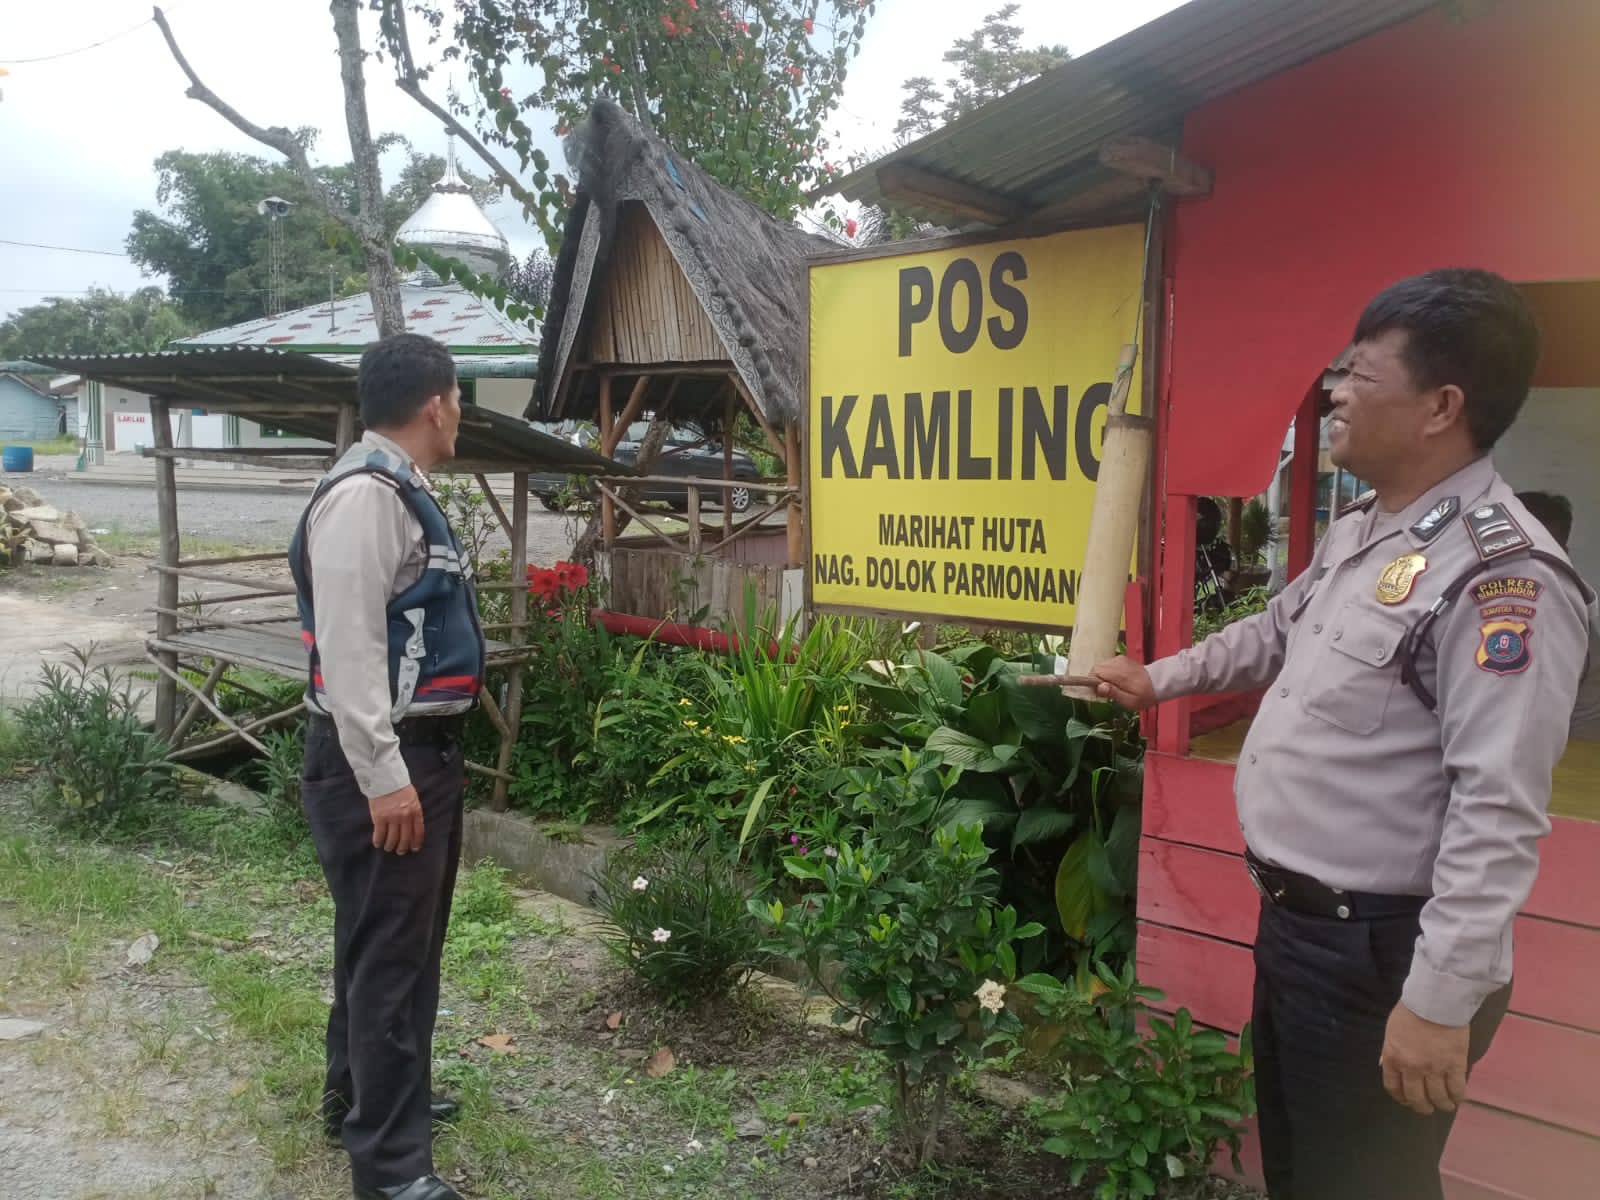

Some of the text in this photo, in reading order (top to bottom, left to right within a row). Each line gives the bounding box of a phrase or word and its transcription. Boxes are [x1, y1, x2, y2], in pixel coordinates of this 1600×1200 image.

[898, 251, 1028, 357] POS
[878, 514, 1047, 554] MARIHAT HUTA
[814, 553, 860, 586] NAG.
[866, 556, 937, 593] DOLOK
[1480, 579, 1535, 592] POLRES
